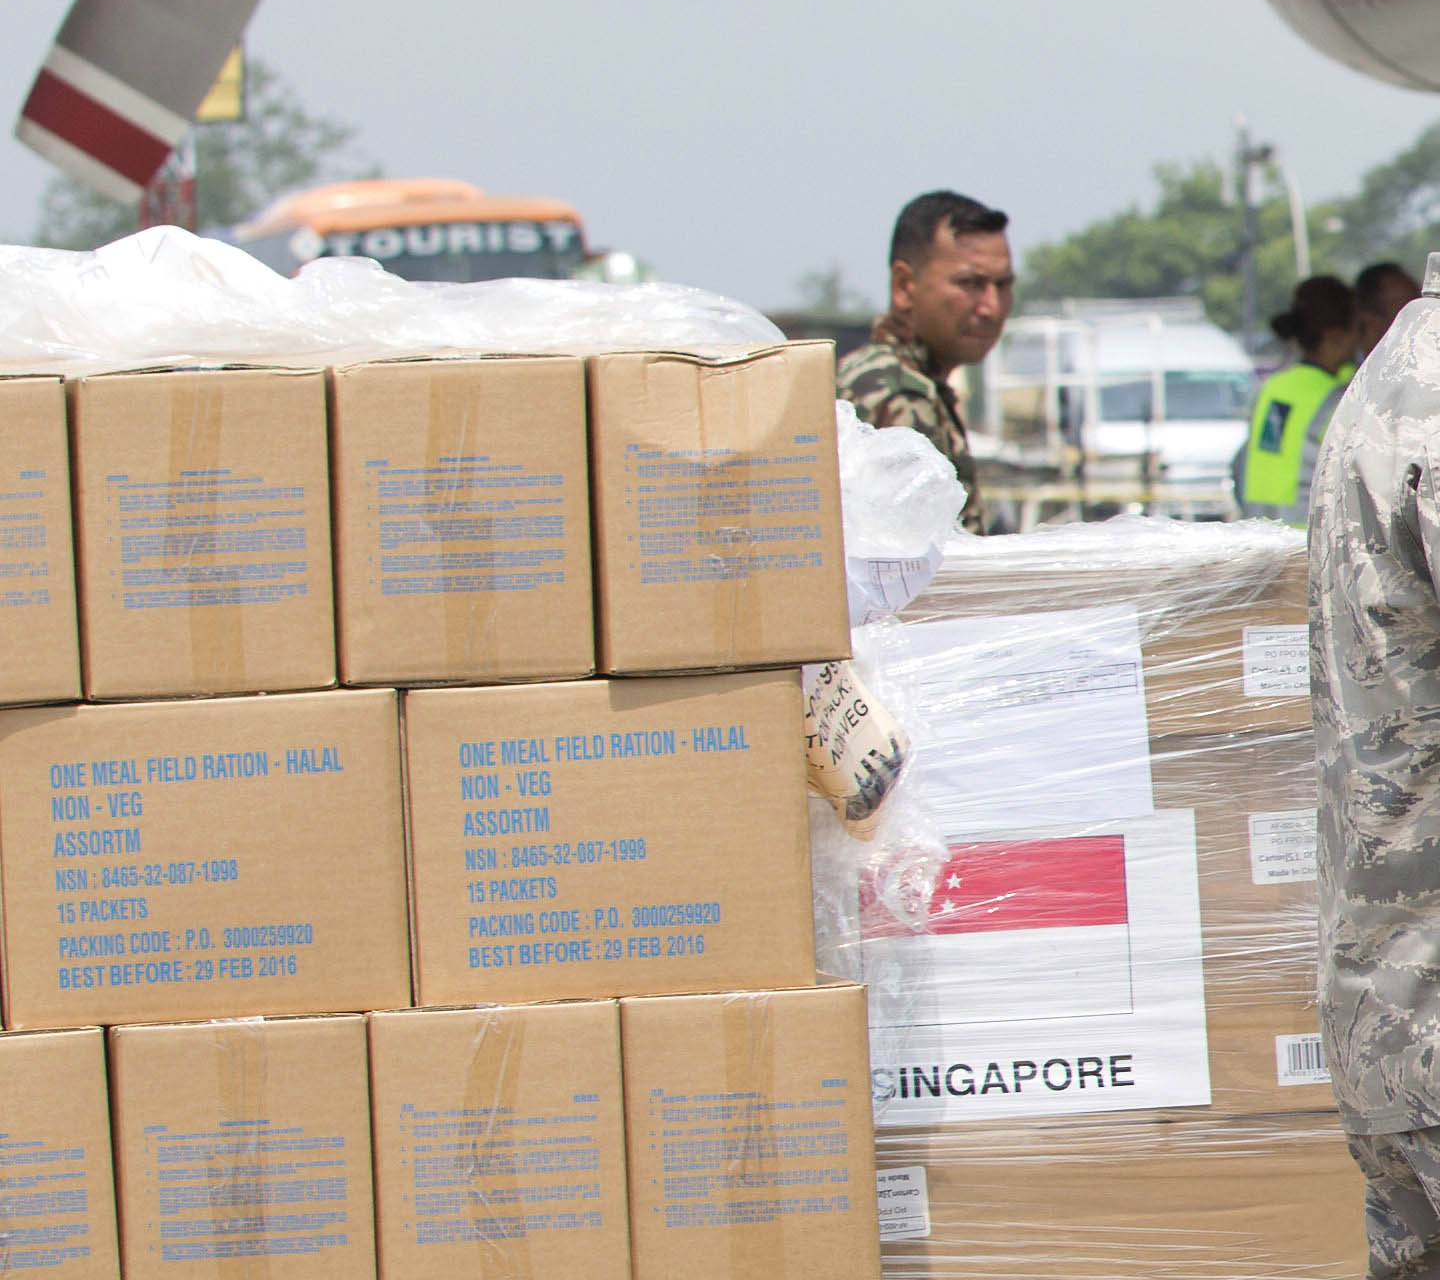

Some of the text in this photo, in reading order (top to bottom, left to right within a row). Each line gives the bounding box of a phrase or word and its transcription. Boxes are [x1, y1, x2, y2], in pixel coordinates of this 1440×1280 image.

[325, 220, 579, 259] TOURIST
[458, 741, 496, 769] ONE
[500, 739, 551, 765] MEAL
[554, 734, 605, 761] FIELD
[608, 730, 676, 758] RATION
[692, 725, 751, 753] HALAL
[49, 762, 87, 790] ONE
[91, 759, 143, 786] MEAL
[146, 755, 197, 783] FIELD
[201, 751, 269, 779] RATION
[285, 747, 345, 774] HALAL
[460, 774, 500, 801] NON
[516, 770, 553, 797] VEG
[51, 795, 91, 821] NON
[107, 791, 144, 819] VEG
[463, 807, 550, 837] ASSORTM
[53, 827, 142, 857] ASSORTM
[464, 847, 497, 871] NSN
[509, 837, 647, 869] 8465-32-087-1998
[55, 868, 88, 892] NSN
[101, 859, 240, 889] 8465-32-087-1998
[466, 876, 557, 904] 15 PACKETS
[56, 897, 149, 924] 15 PACKETS
[468, 912, 535, 937] PACKING
[538, 909, 581, 934] CODE
[630, 902, 721, 929] 3000259920
[58, 933, 126, 958] PACKING
[129, 930, 172, 955] CODE
[222, 923, 314, 949] 3000259920
[468, 944, 515, 969] BEST
[626, 935, 662, 958] FEB
[664, 933, 705, 957] 2016
[58, 965, 106, 989] BEST
[218, 956, 254, 979] FEB
[257, 954, 298, 977] 2016
[872, 1054, 1135, 1102] SINGAPORE
